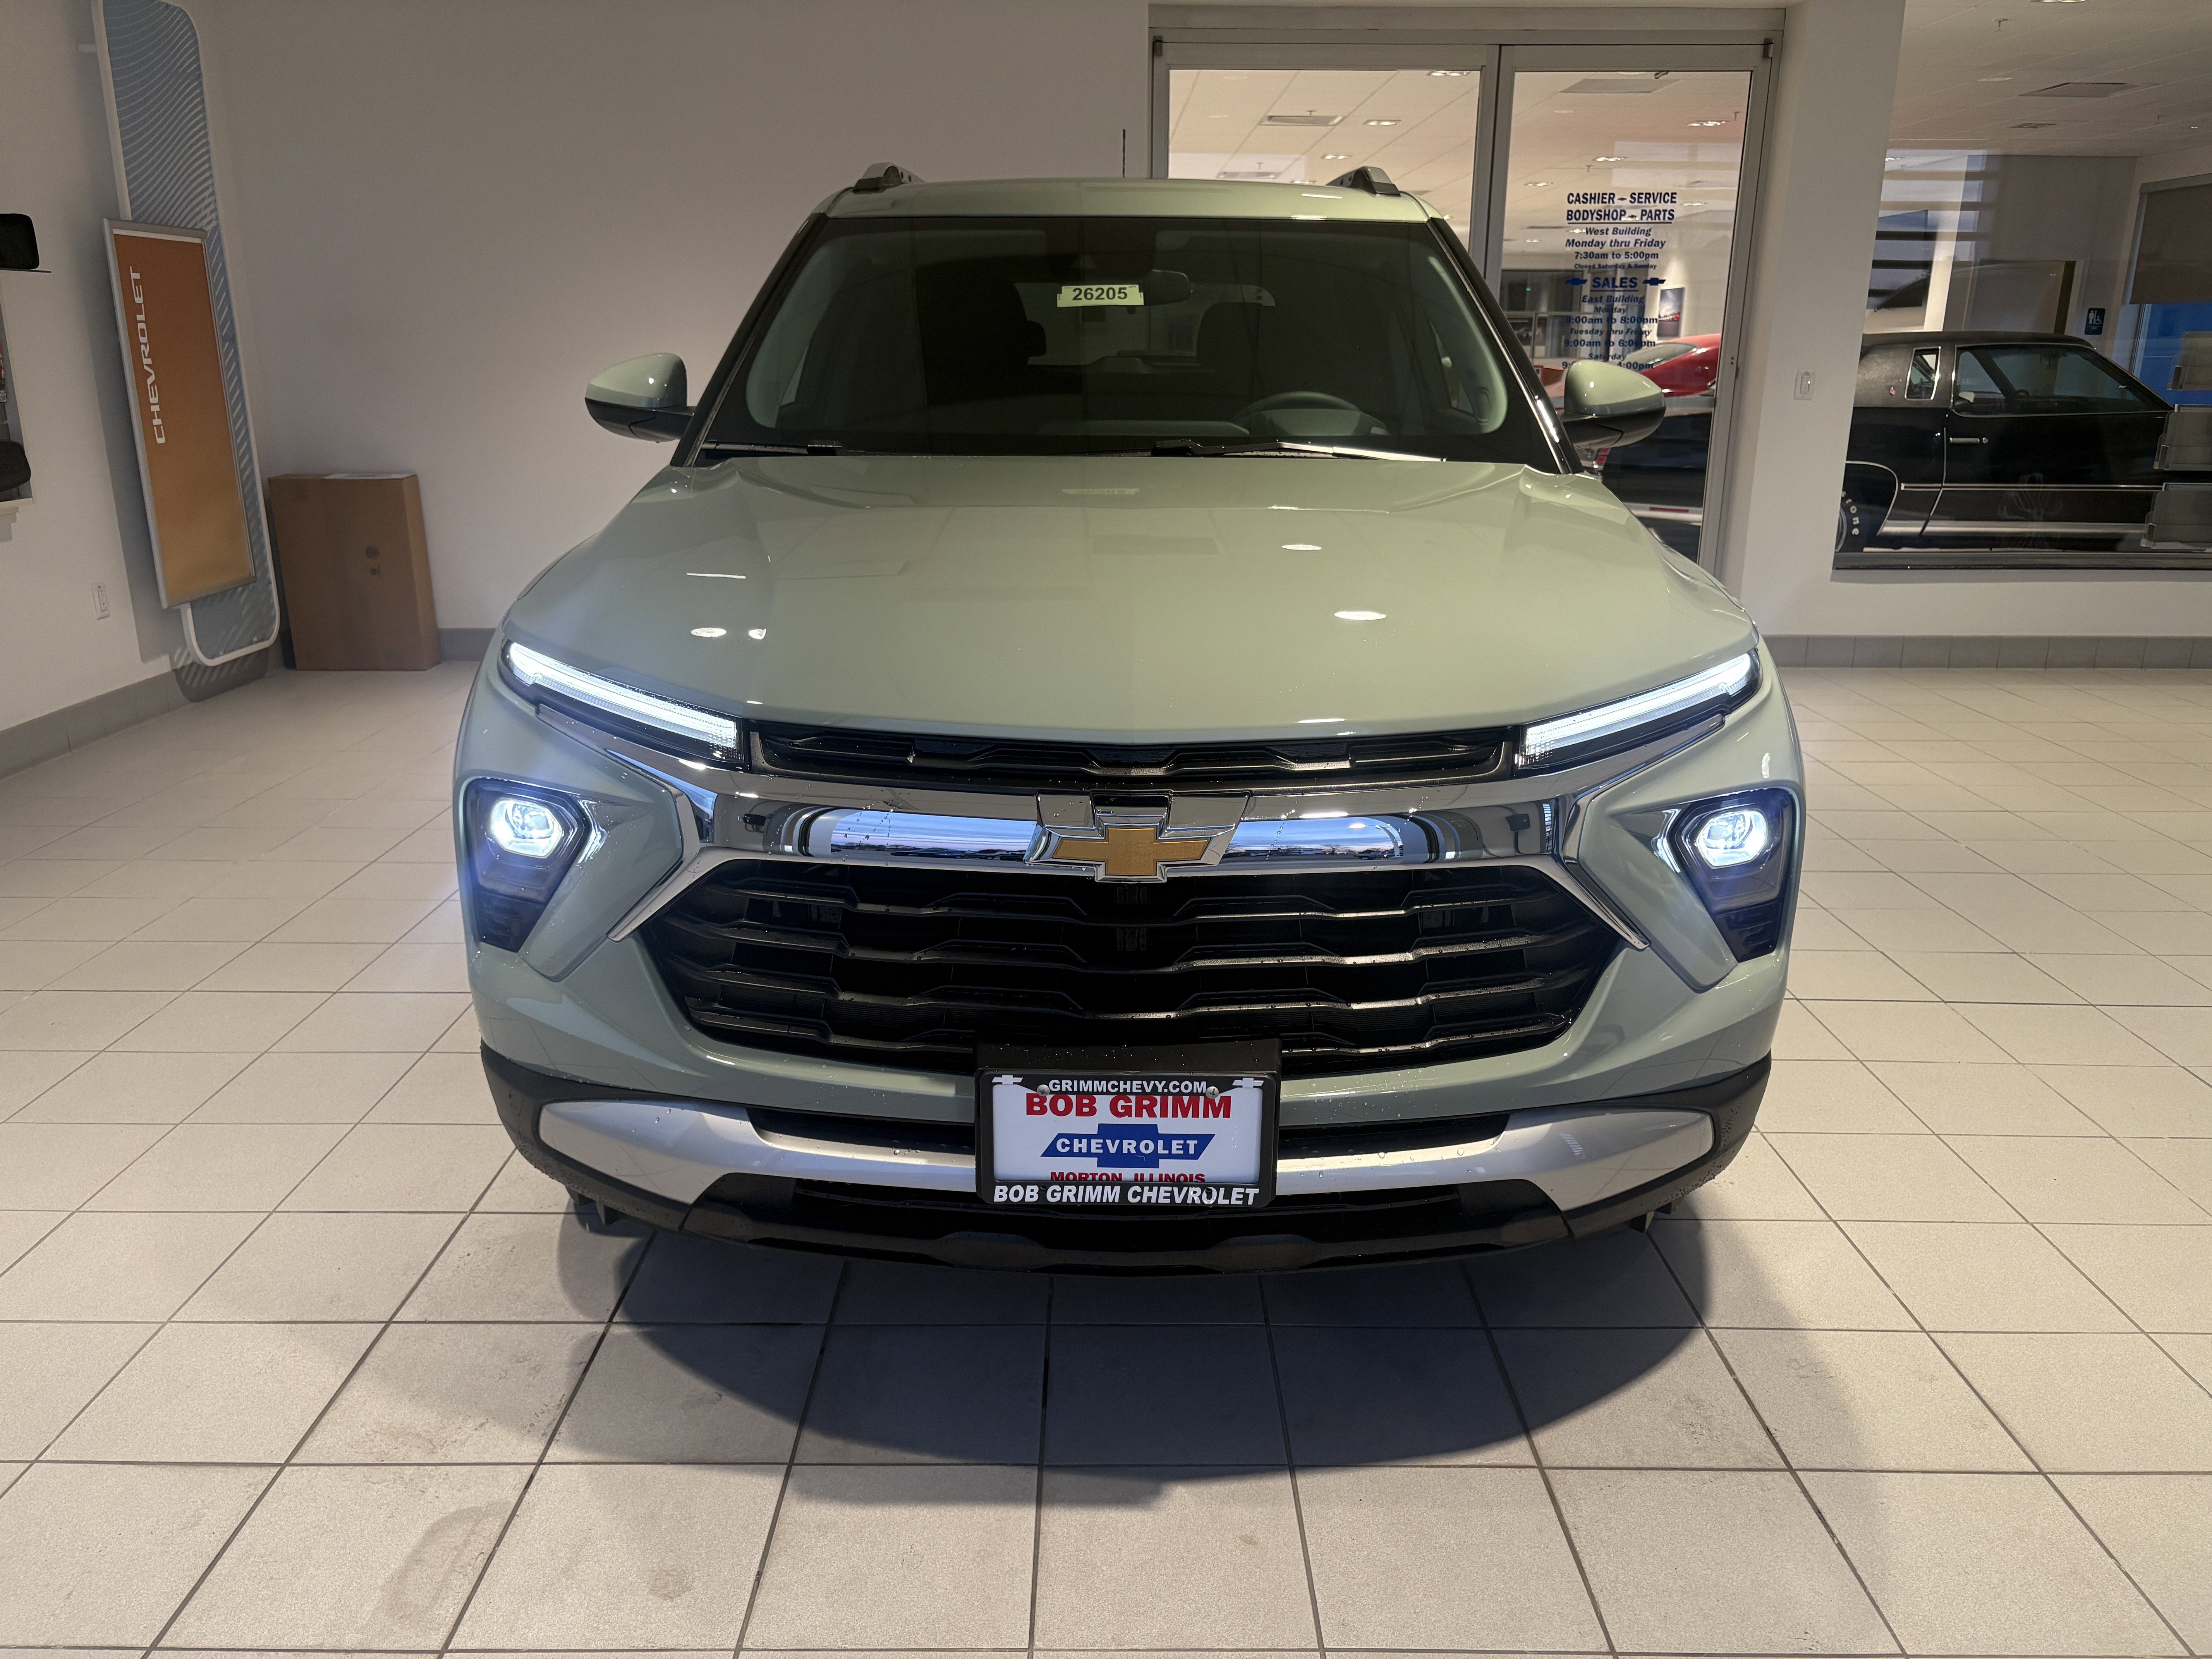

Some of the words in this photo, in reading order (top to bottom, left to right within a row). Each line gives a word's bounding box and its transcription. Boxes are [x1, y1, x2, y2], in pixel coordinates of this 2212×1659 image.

[1567, 193, 1615, 204] CASHIER
[1629, 192, 1677, 204] SERVICE
[1566, 210, 1626, 221] BODYSHOP
[1640, 209, 1674, 220] PARTS
[1612, 227, 1652, 237] Building
[1565, 239, 1606, 249] Monday
[1609, 239, 1630, 247] thru
[1634, 239, 1666, 249] Friday
[1625, 252, 1659, 261] 5:00pm
[1592, 277, 1638, 288] SALES
[1072, 287, 1128, 301] 26205
[1606, 295, 1645, 304] Building
[1626, 328, 1652, 337] Friay
[130, 266, 166, 444] CHEVROLET
[1049, 1079, 1206, 1094] GRIMMCHEVY.COM
[1026, 1093, 1097, 1118] BOB
[1109, 1094, 1231, 1118] GRIMM
[1056, 1138, 1198, 1154] CHEVROLET
[1050, 1171, 1122, 1182] MORTON
[993, 1185, 1039, 1203] BOB
[1046, 1185, 1120, 1203] GRIMM
[1127, 1185, 1259, 1206] CHEVROLET
